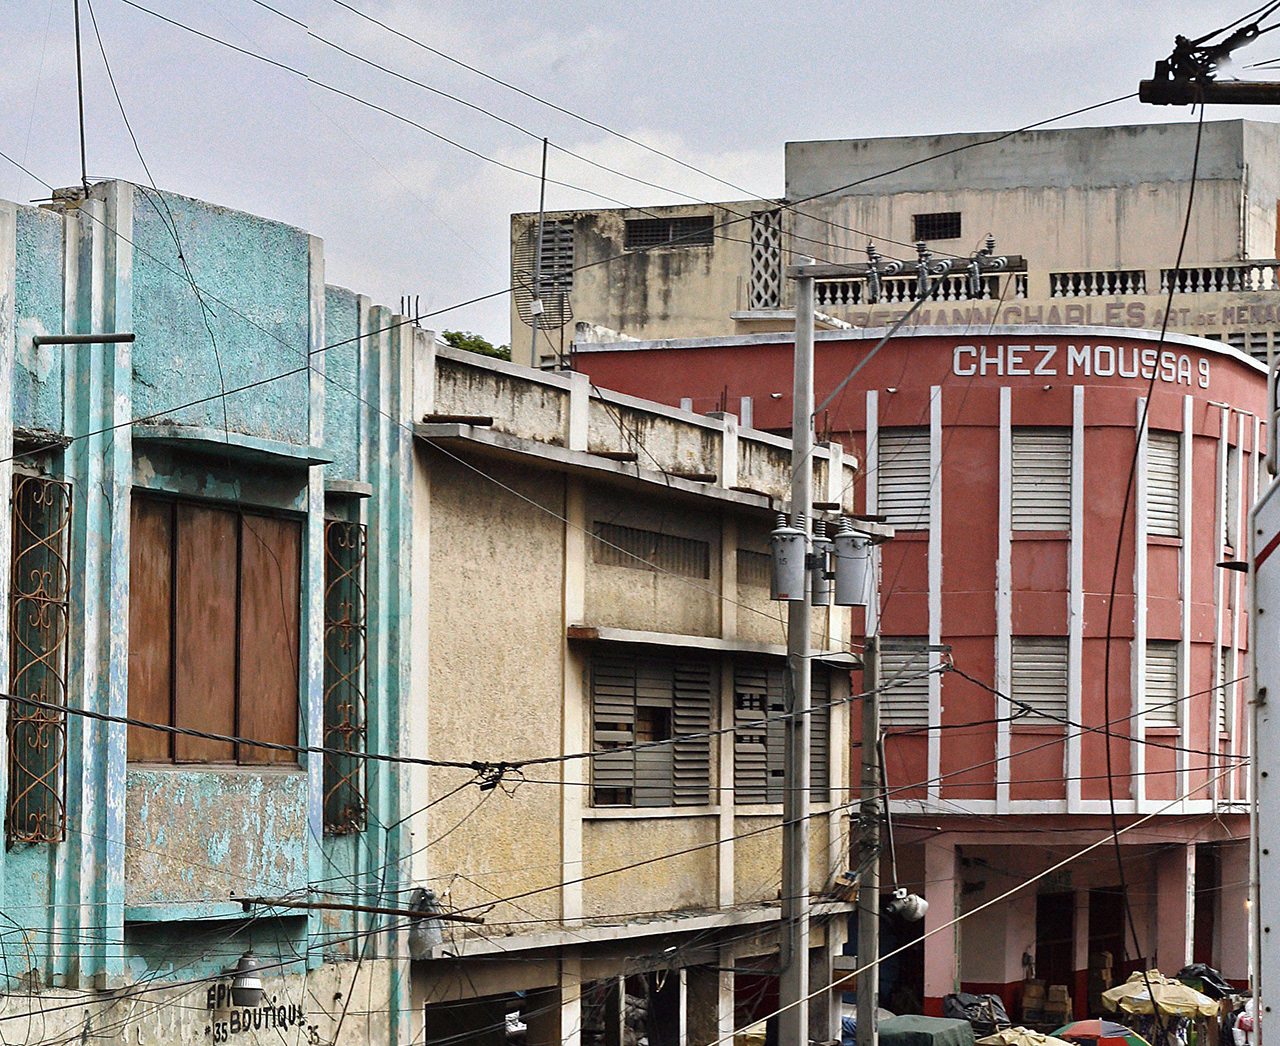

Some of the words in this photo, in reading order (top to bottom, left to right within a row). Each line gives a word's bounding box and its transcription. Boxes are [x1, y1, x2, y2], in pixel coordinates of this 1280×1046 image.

[1003, 302, 1145, 328] CHARLES
[951, 344, 1055, 376] CHEZ
[1065, 345, 1189, 386] MOUSSA
[1195, 357, 1208, 388] 9
